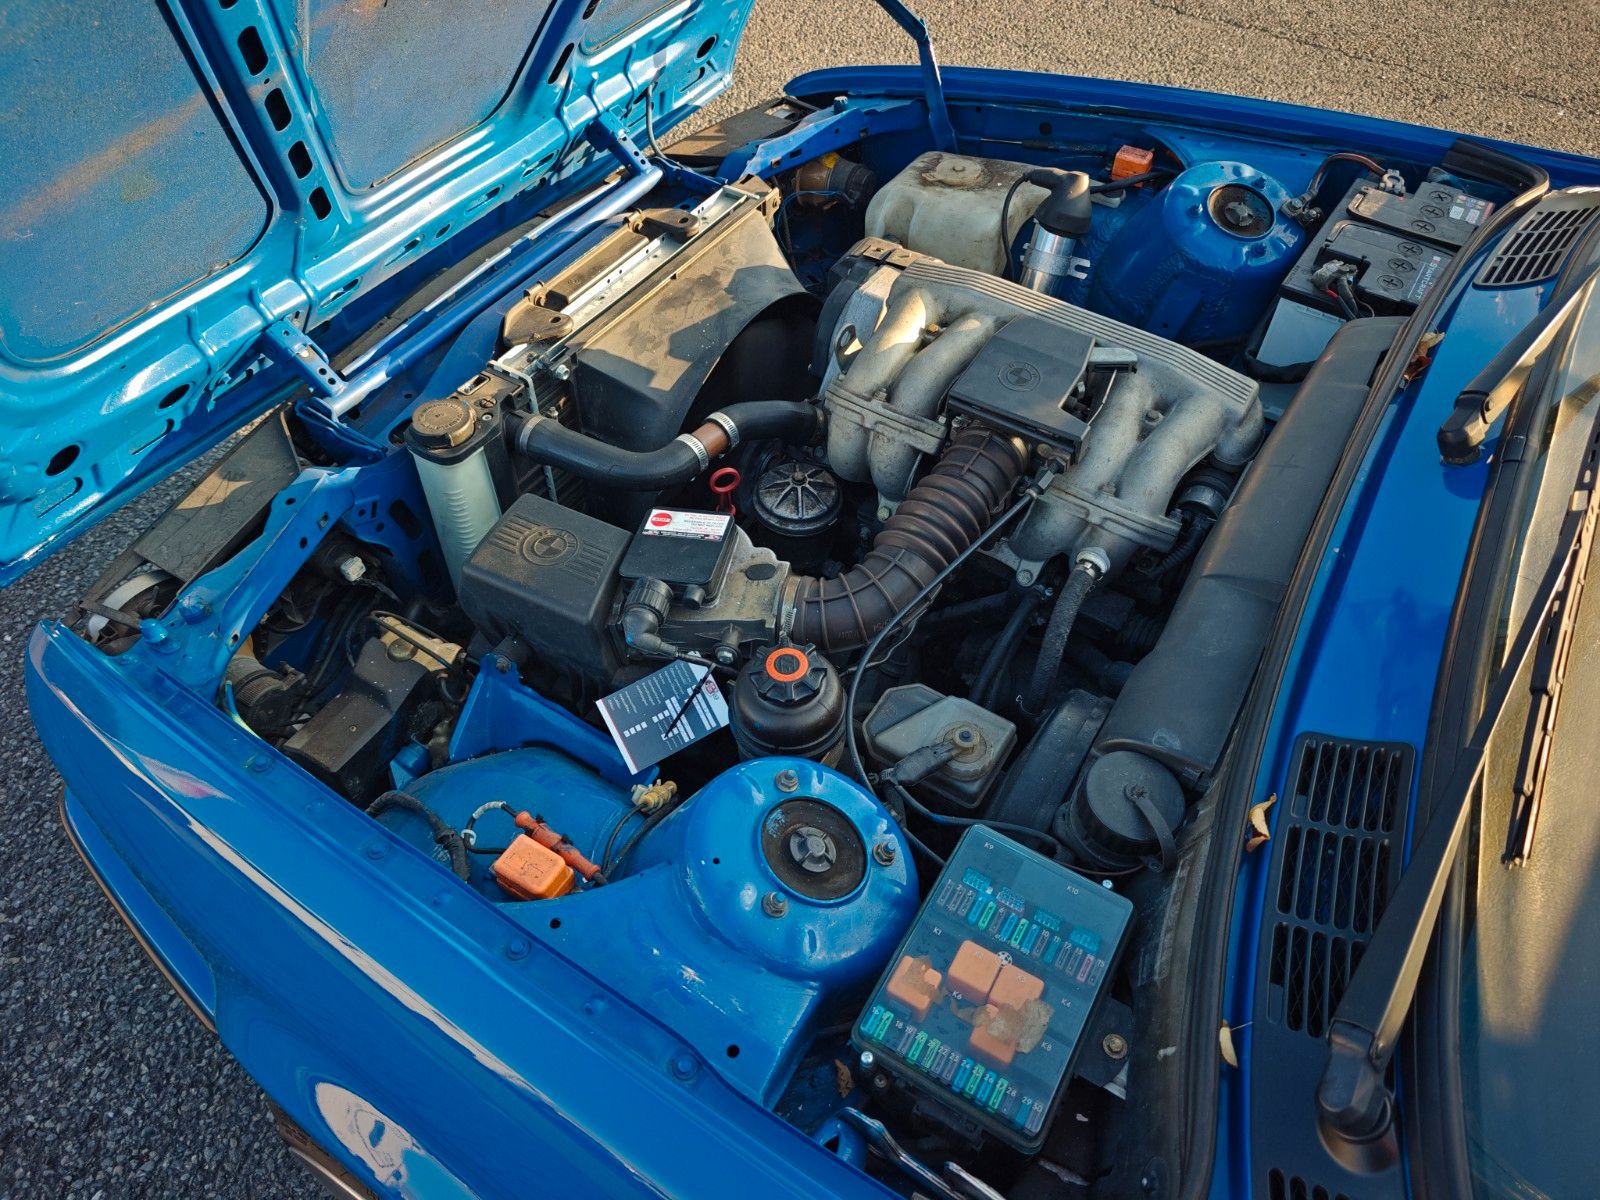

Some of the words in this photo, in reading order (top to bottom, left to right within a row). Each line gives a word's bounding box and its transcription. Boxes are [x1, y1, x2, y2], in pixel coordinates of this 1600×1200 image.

[984, 842, 994, 850] K9
[1066, 885, 1079, 895] K10
[1041, 929, 1050, 937] 10
[872, 1007, 880, 1015] 16
[895, 1020, 904, 1029] 18
[905, 1026, 913, 1034] 19
[938, 1047, 948, 1055] 22
[961, 1059, 971, 1069] 24
[984, 1073, 994, 1083] 26
[1006, 1087, 1017, 1097] 28
[1021, 1096, 1032, 1105] 29
